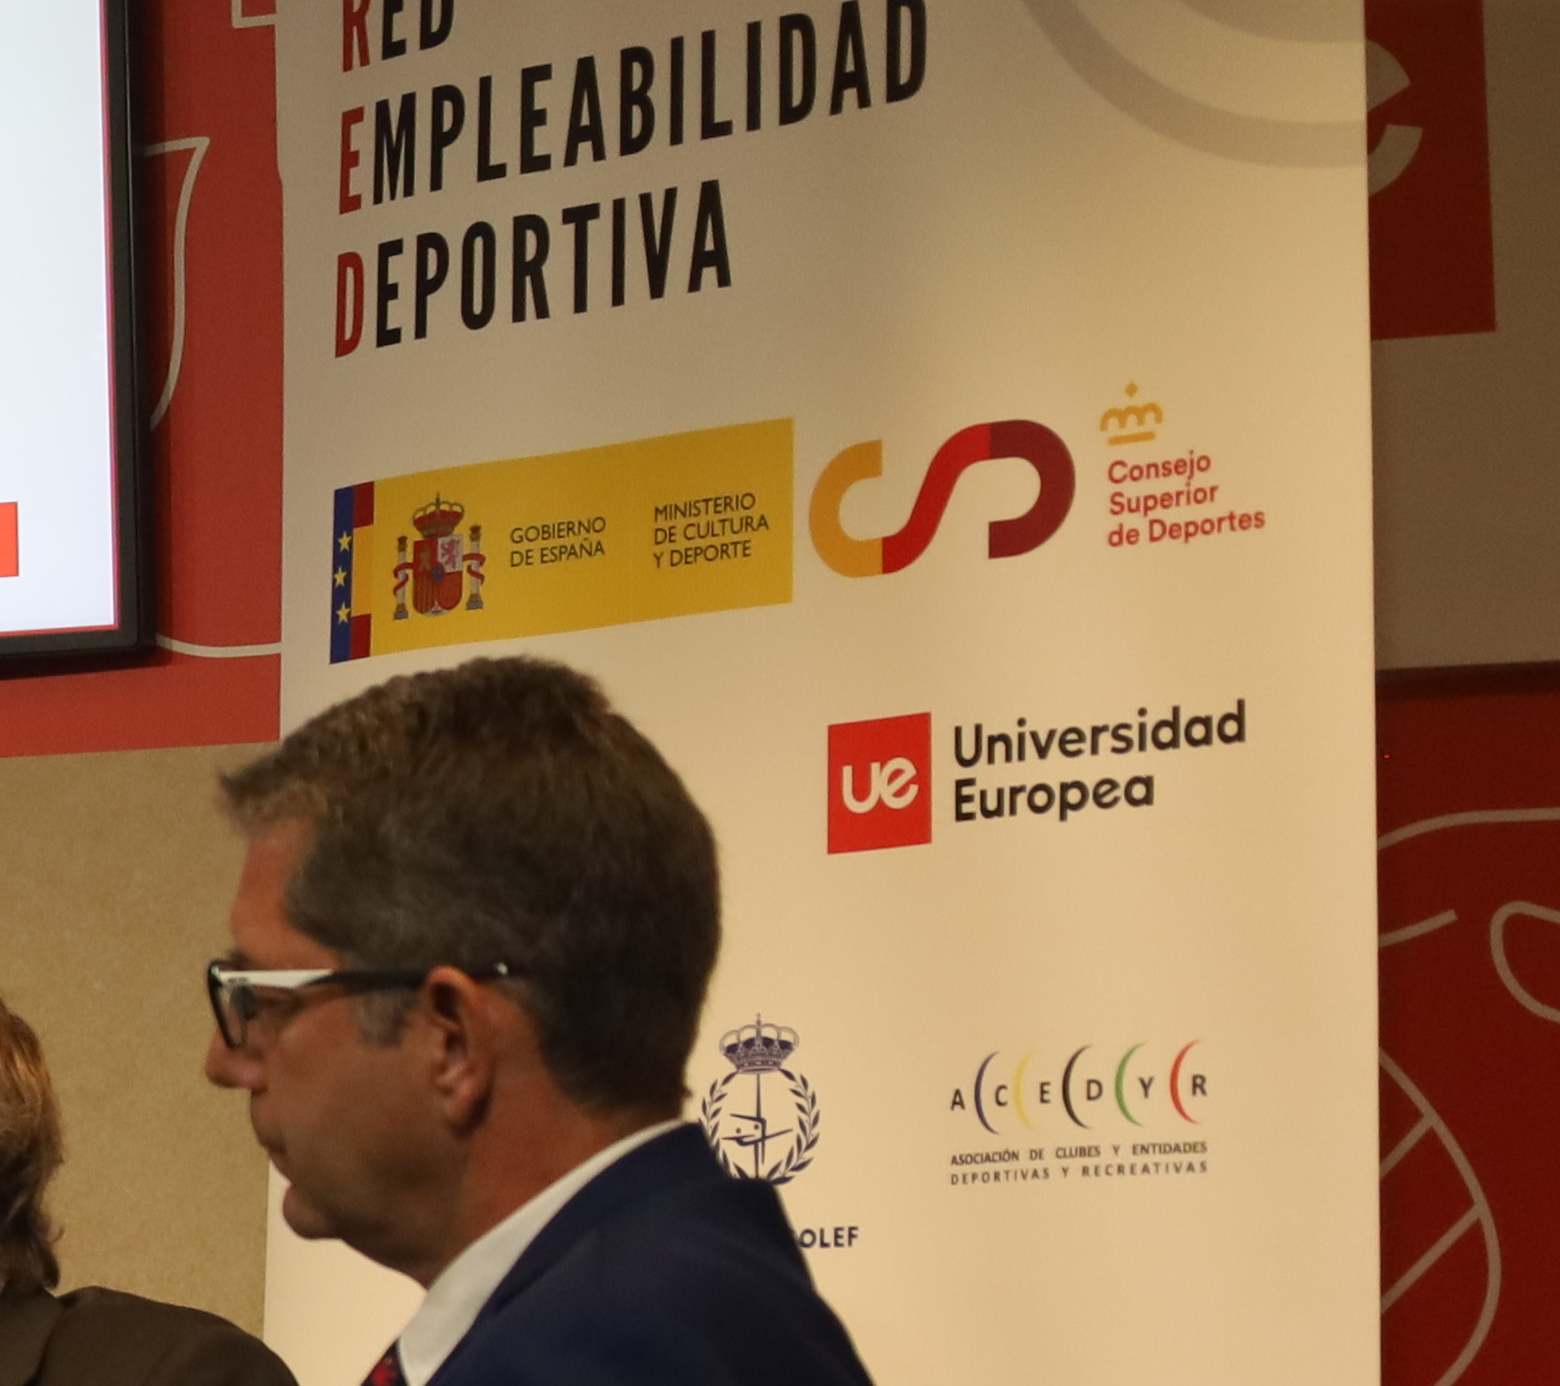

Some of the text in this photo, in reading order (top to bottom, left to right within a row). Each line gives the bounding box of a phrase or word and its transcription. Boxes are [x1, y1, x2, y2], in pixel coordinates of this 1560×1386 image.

[334, 179, 732, 358] DEPORTIVA
[1108, 449, 1211, 484] Consejo
[654, 493, 756, 523] MINISTERIO
[1110, 481, 1218, 517] Superior
[510, 516, 606, 544] GOBIERNO
[654, 514, 769, 545] DE CULTURA
[1108, 511, 1265, 547] de Deportes
[510, 538, 606, 567] DE ESPAÑA
[653, 540, 751, 568] Y DEPORTE
[953, 698, 1246, 768] Universidad
[841, 756, 918, 815] ue
[953, 771, 1155, 822] Europea
[951, 1141, 1207, 1166] ASOCIACIÓN DE CLUBES Y ENTIDADES
[951, 1160, 1207, 1185] DEPORTIVAS Y RECREATIVAS
[799, 1226, 858, 1249] OLEF
